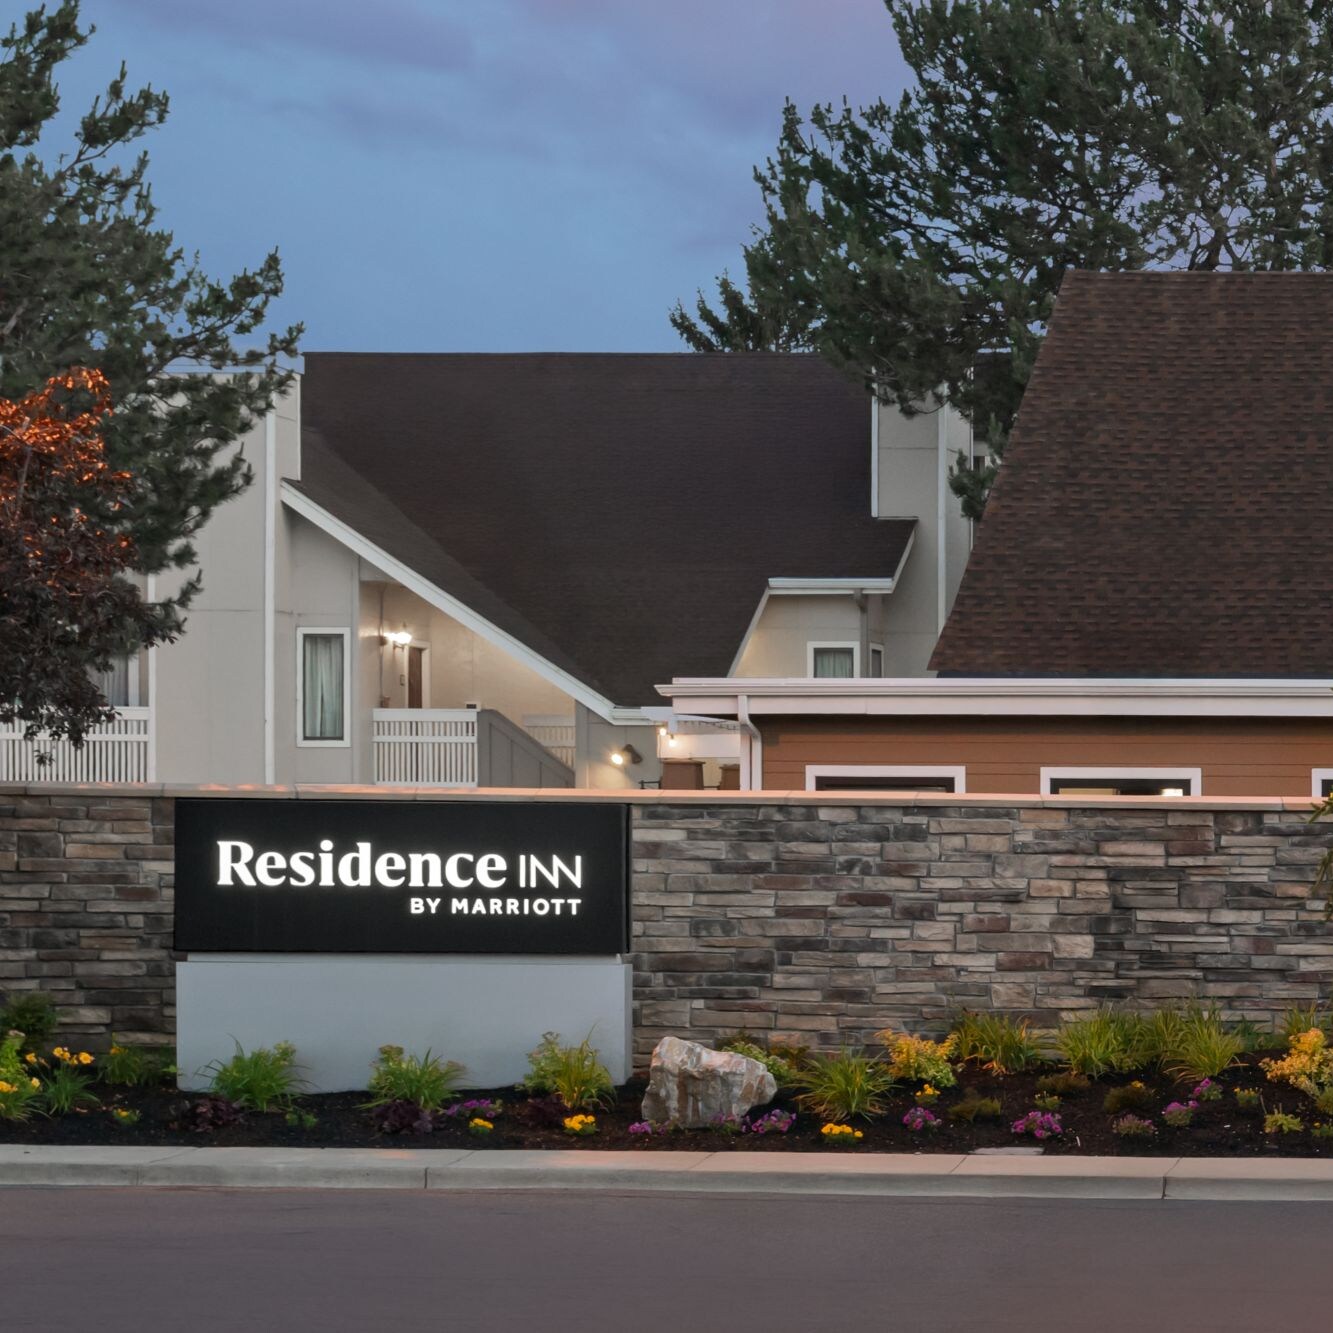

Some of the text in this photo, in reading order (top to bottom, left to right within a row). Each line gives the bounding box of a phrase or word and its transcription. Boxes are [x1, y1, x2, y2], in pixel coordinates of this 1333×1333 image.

[217, 839, 582, 889] Residence INN
[410, 898, 582, 915] BY MARRIOTT
